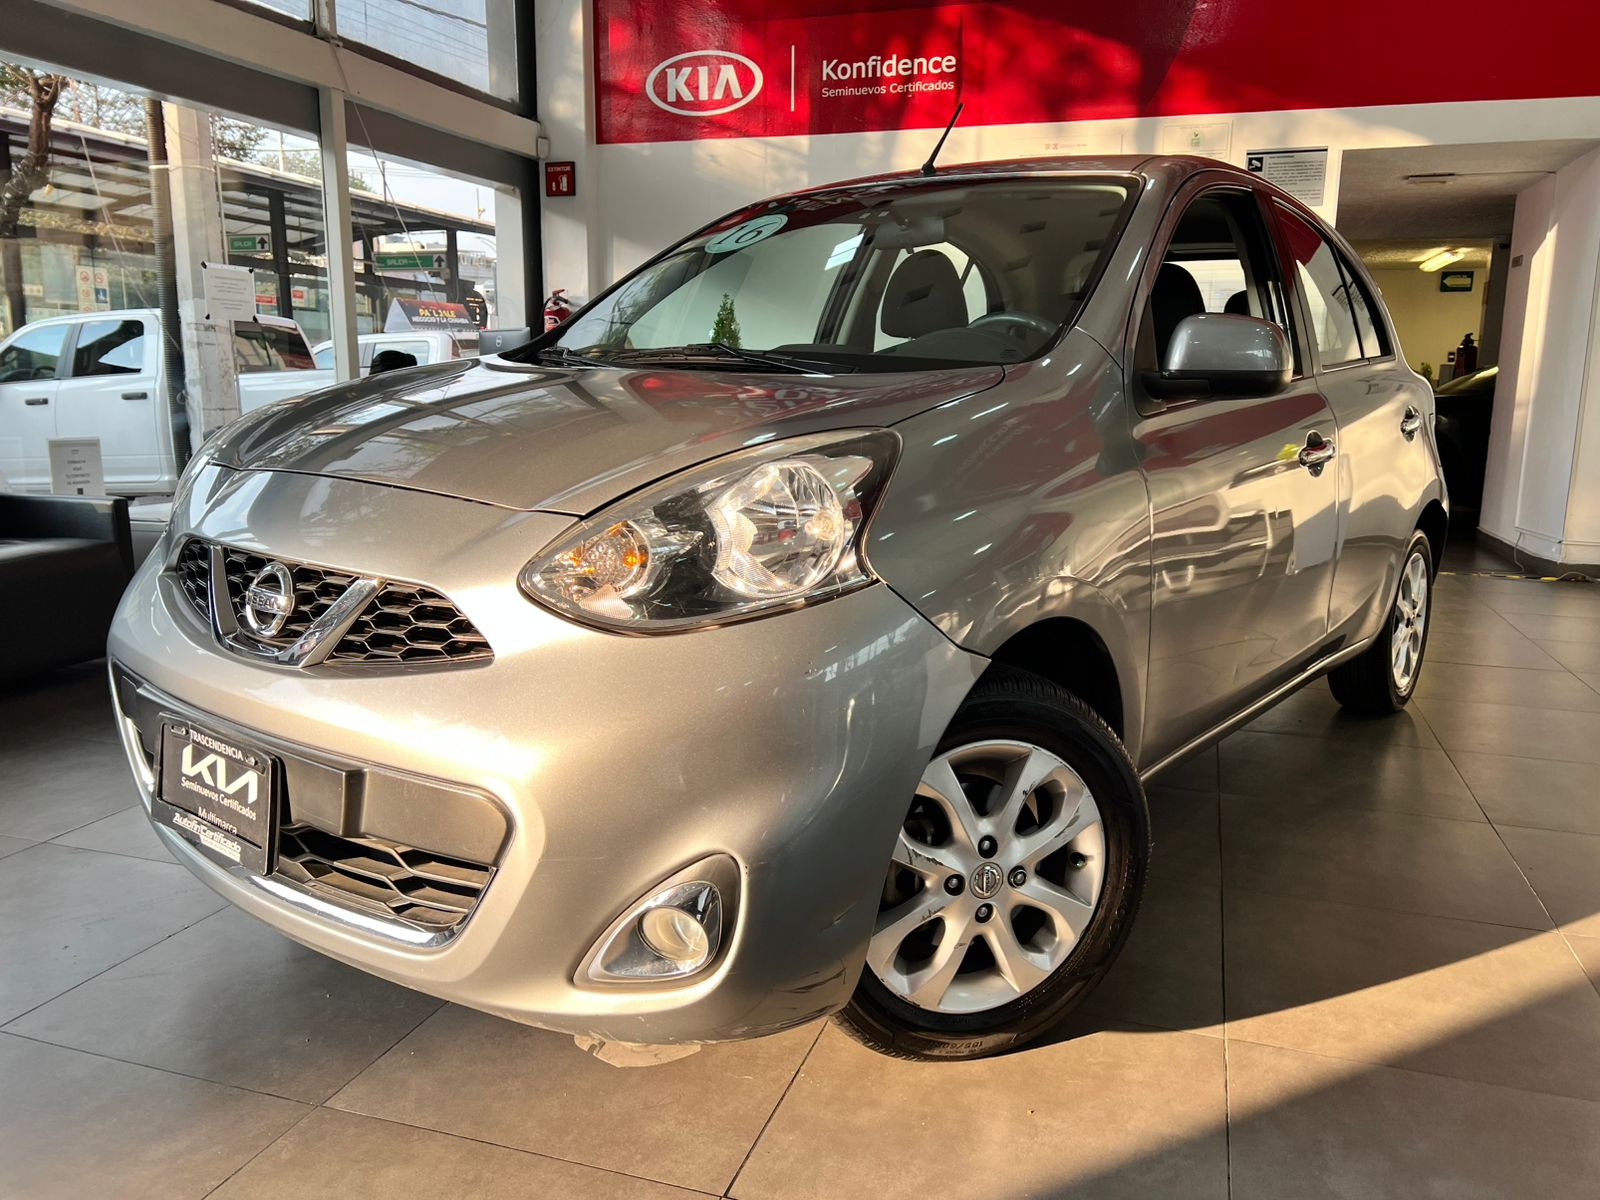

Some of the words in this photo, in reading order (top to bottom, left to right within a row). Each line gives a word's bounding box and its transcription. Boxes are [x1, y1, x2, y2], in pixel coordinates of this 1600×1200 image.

[822, 53, 956, 81] Konfidence
[665, 64, 743, 102] KIA
[822, 85, 887, 97] Seminuevos
[889, 80, 955, 94] Certificados
[712, 221, 780, 245] 16
[190, 729, 244, 761] TRASCENDENCIA
[181, 776, 219, 802] Seminuevos
[219, 794, 257, 821] Certificados
[198, 806, 238, 835] Multimarca
